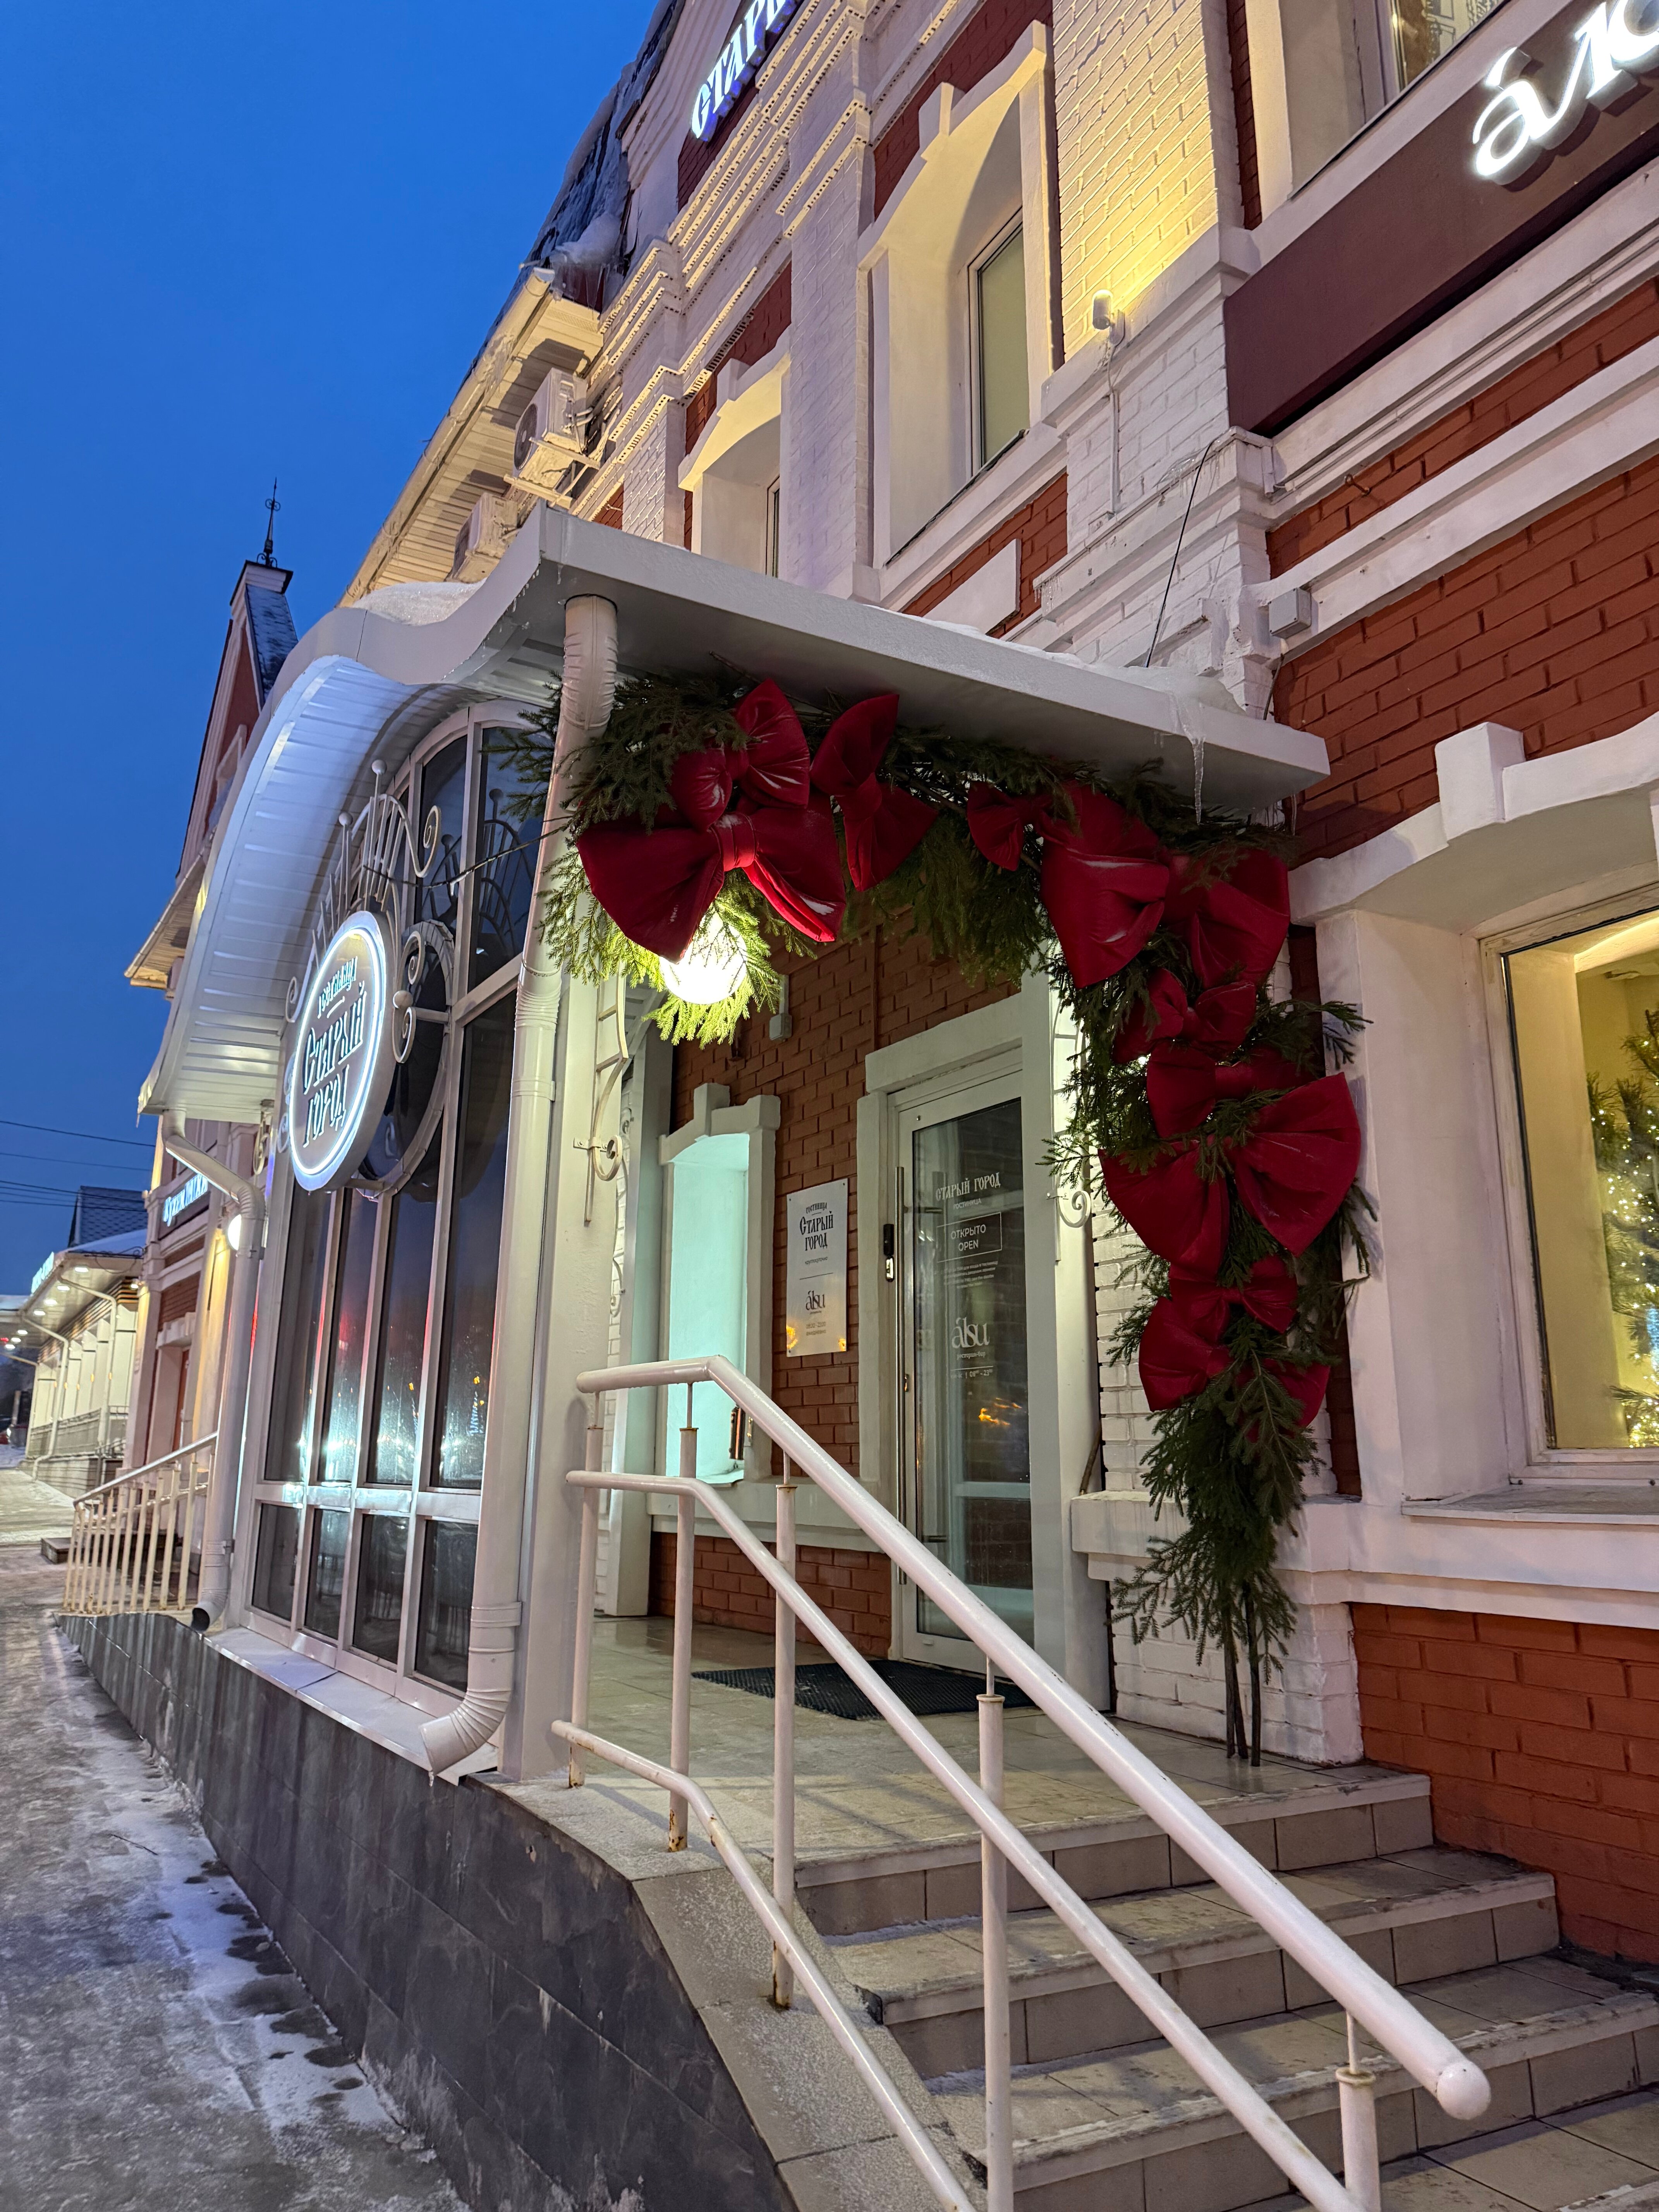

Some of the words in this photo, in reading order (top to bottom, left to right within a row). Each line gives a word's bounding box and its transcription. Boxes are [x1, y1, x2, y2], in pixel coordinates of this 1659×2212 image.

[974, 1172, 1001, 1192] ГОРОД
[954, 1198, 982, 1210] ГОСТИНИЦА
[951, 1224, 986, 1239] ОТКРЫТО
[958, 1240, 978, 1251] OPEN
